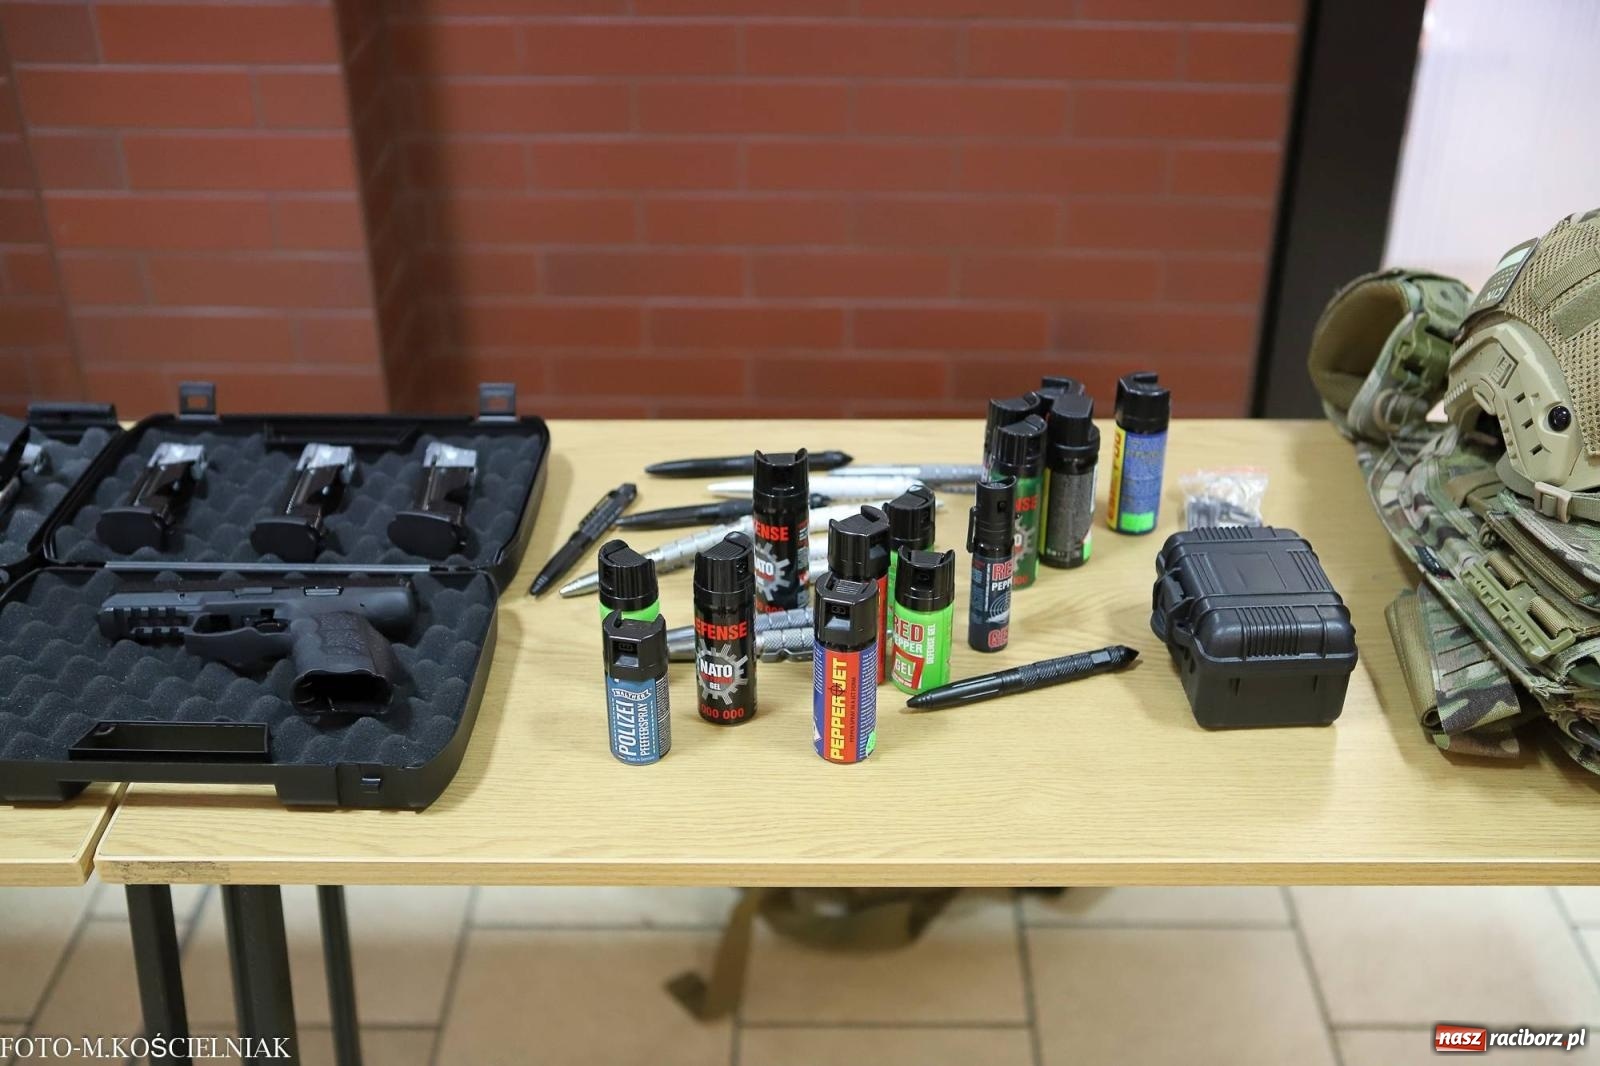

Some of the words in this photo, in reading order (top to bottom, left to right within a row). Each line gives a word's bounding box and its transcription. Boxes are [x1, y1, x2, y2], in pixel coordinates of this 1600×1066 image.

[700, 659, 733, 678] NATO
[895, 658, 913, 677] GEL
[709, 682, 721, 691] GEL
[616, 700, 637, 756] POLIZEI
[638, 703, 650, 756] PFEFFERSPRAY
